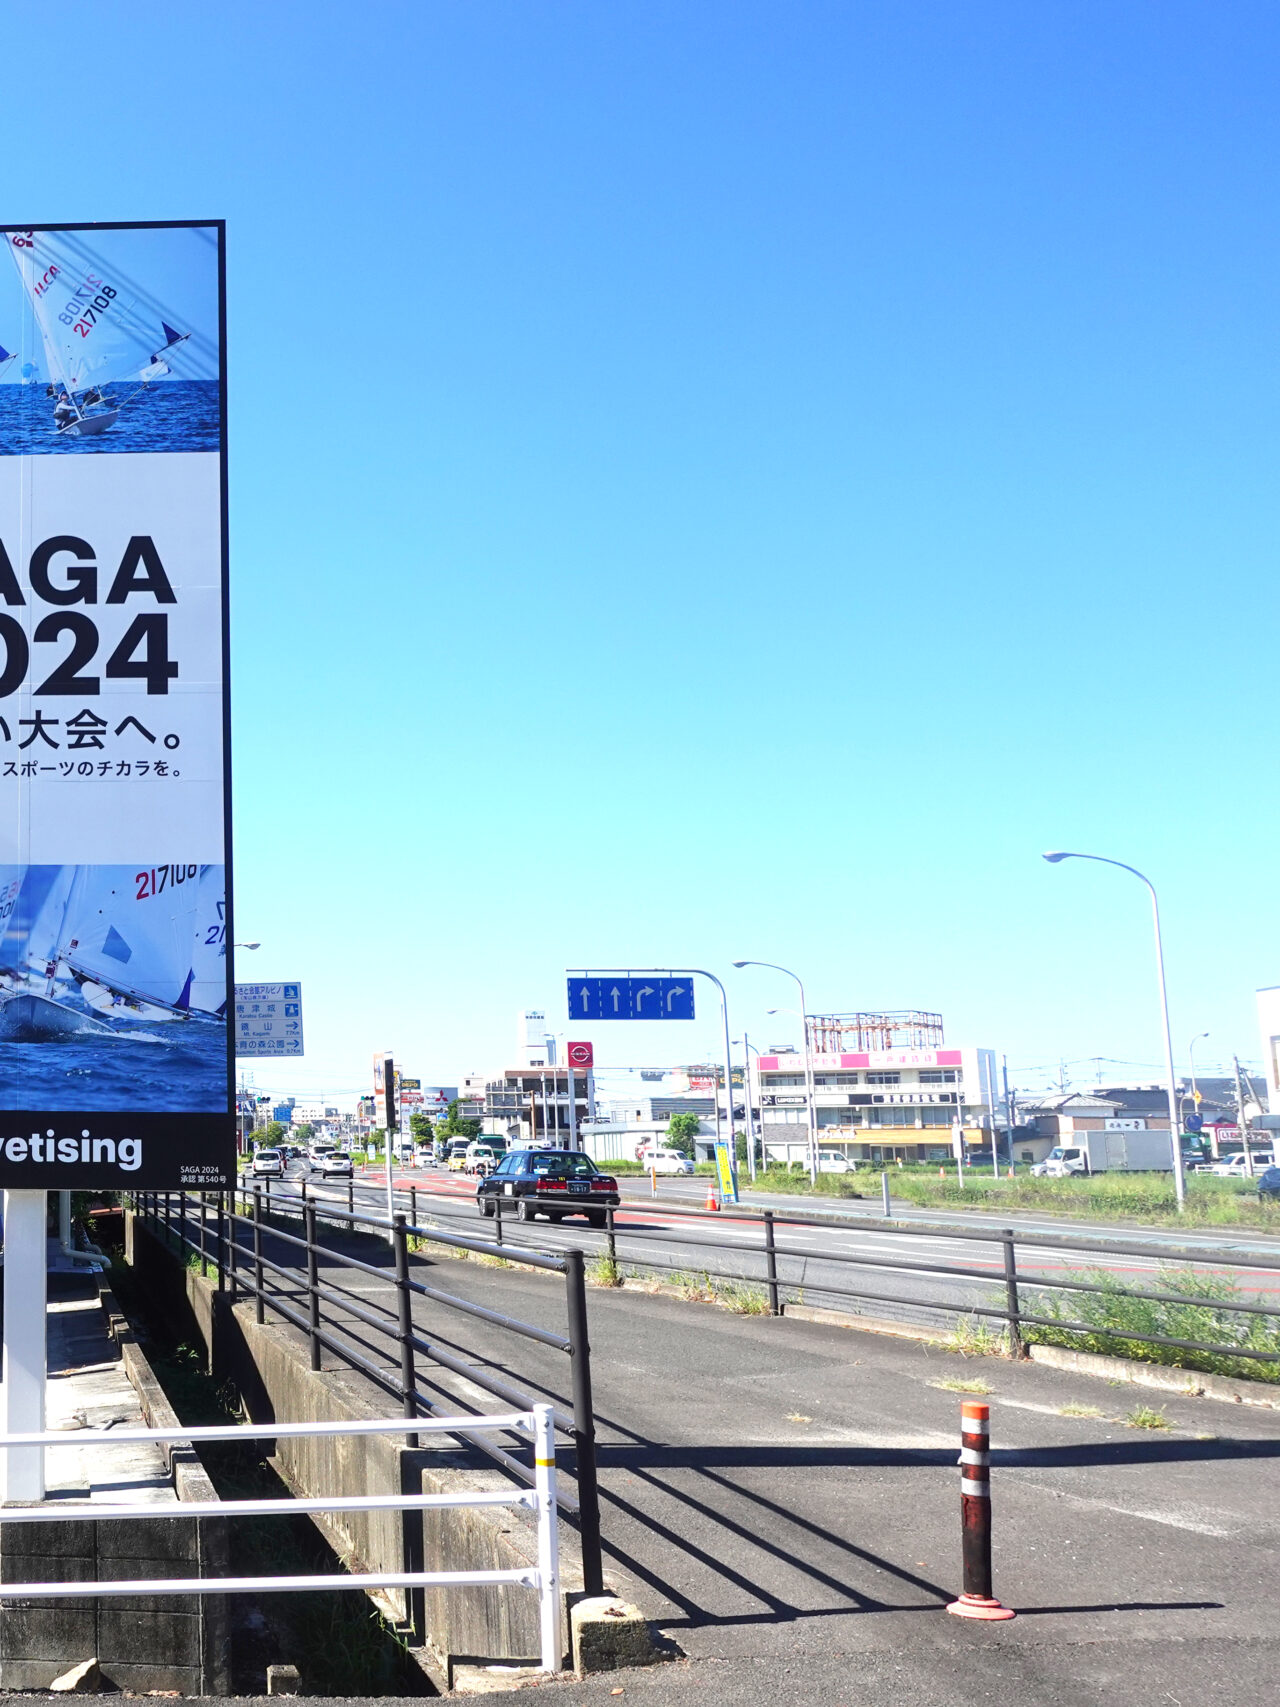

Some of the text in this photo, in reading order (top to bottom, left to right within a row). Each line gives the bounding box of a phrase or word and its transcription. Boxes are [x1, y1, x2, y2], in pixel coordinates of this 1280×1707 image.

[34, 265, 59, 295] ILCA
[73, 286, 117, 338] 217108
[180, 1175, 227, 1184] 承認 第540号
